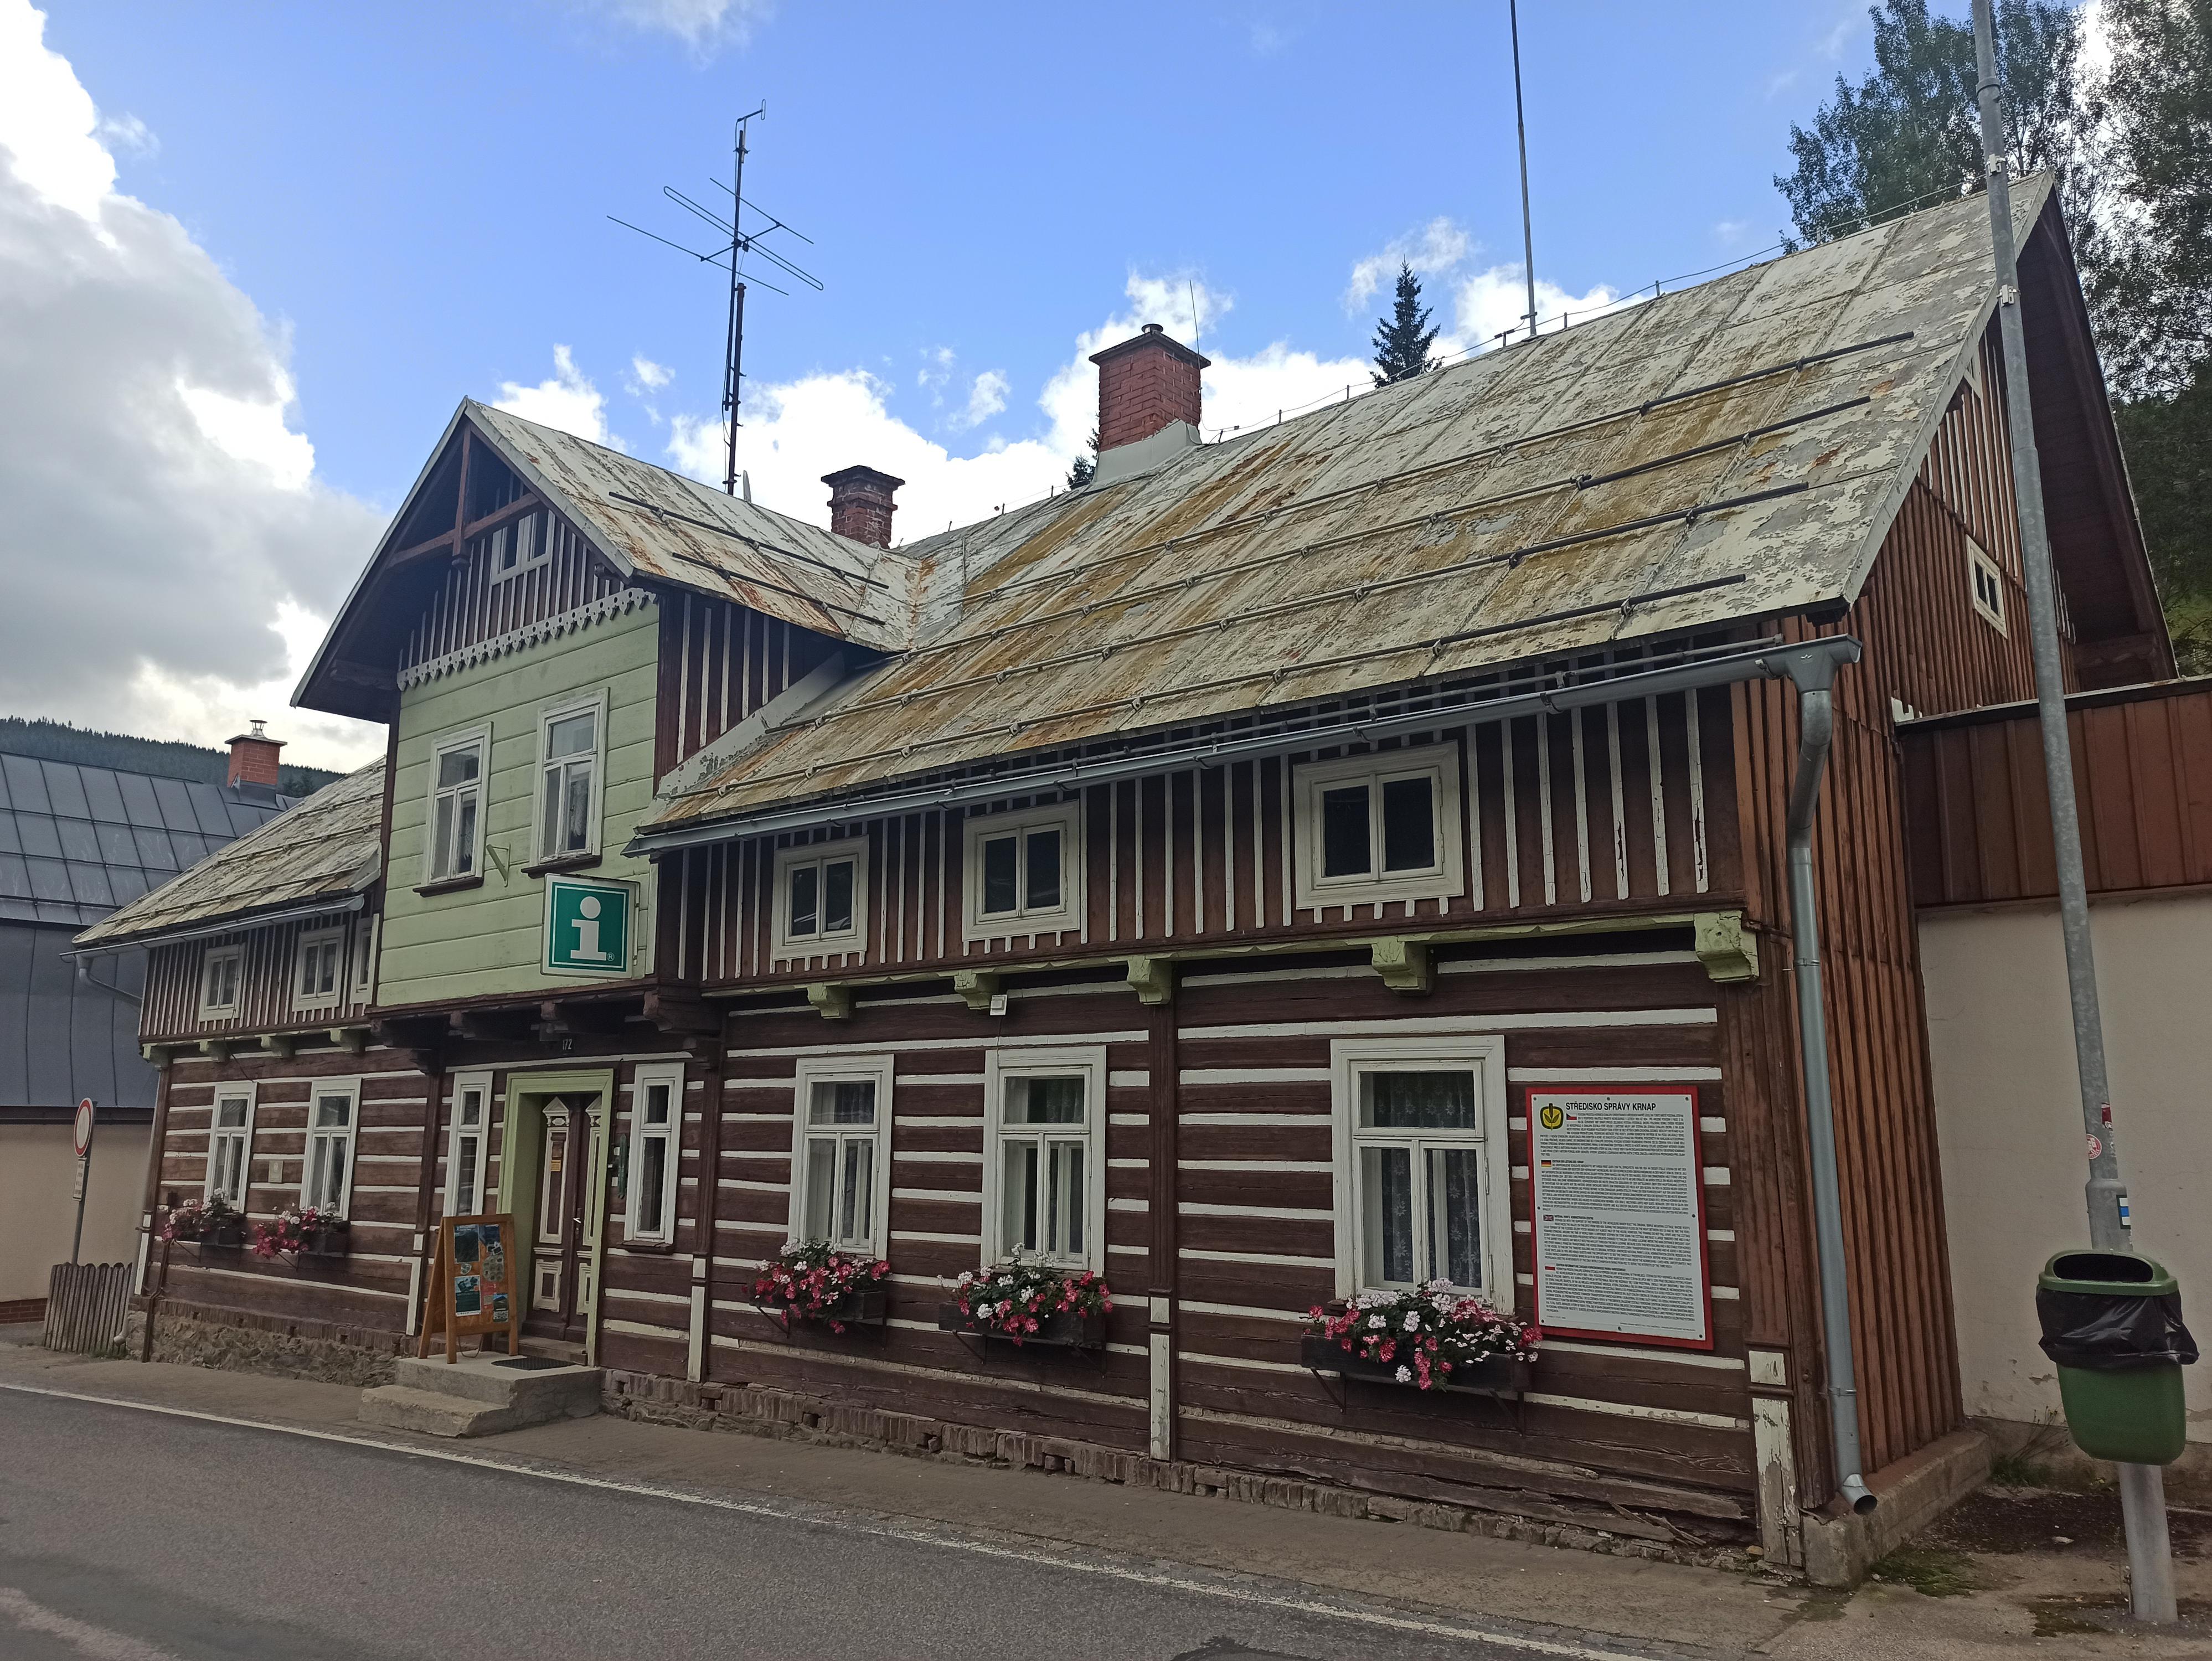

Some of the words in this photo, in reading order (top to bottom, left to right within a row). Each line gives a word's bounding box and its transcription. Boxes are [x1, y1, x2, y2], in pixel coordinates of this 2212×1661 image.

[563, 1039, 572, 1050] 172
[1566, 1101, 1602, 1111] STŘEDISKO
[1603, 1101, 1631, 1111] SPRÁVY
[1632, 1102, 1656, 1111] KRNAP
